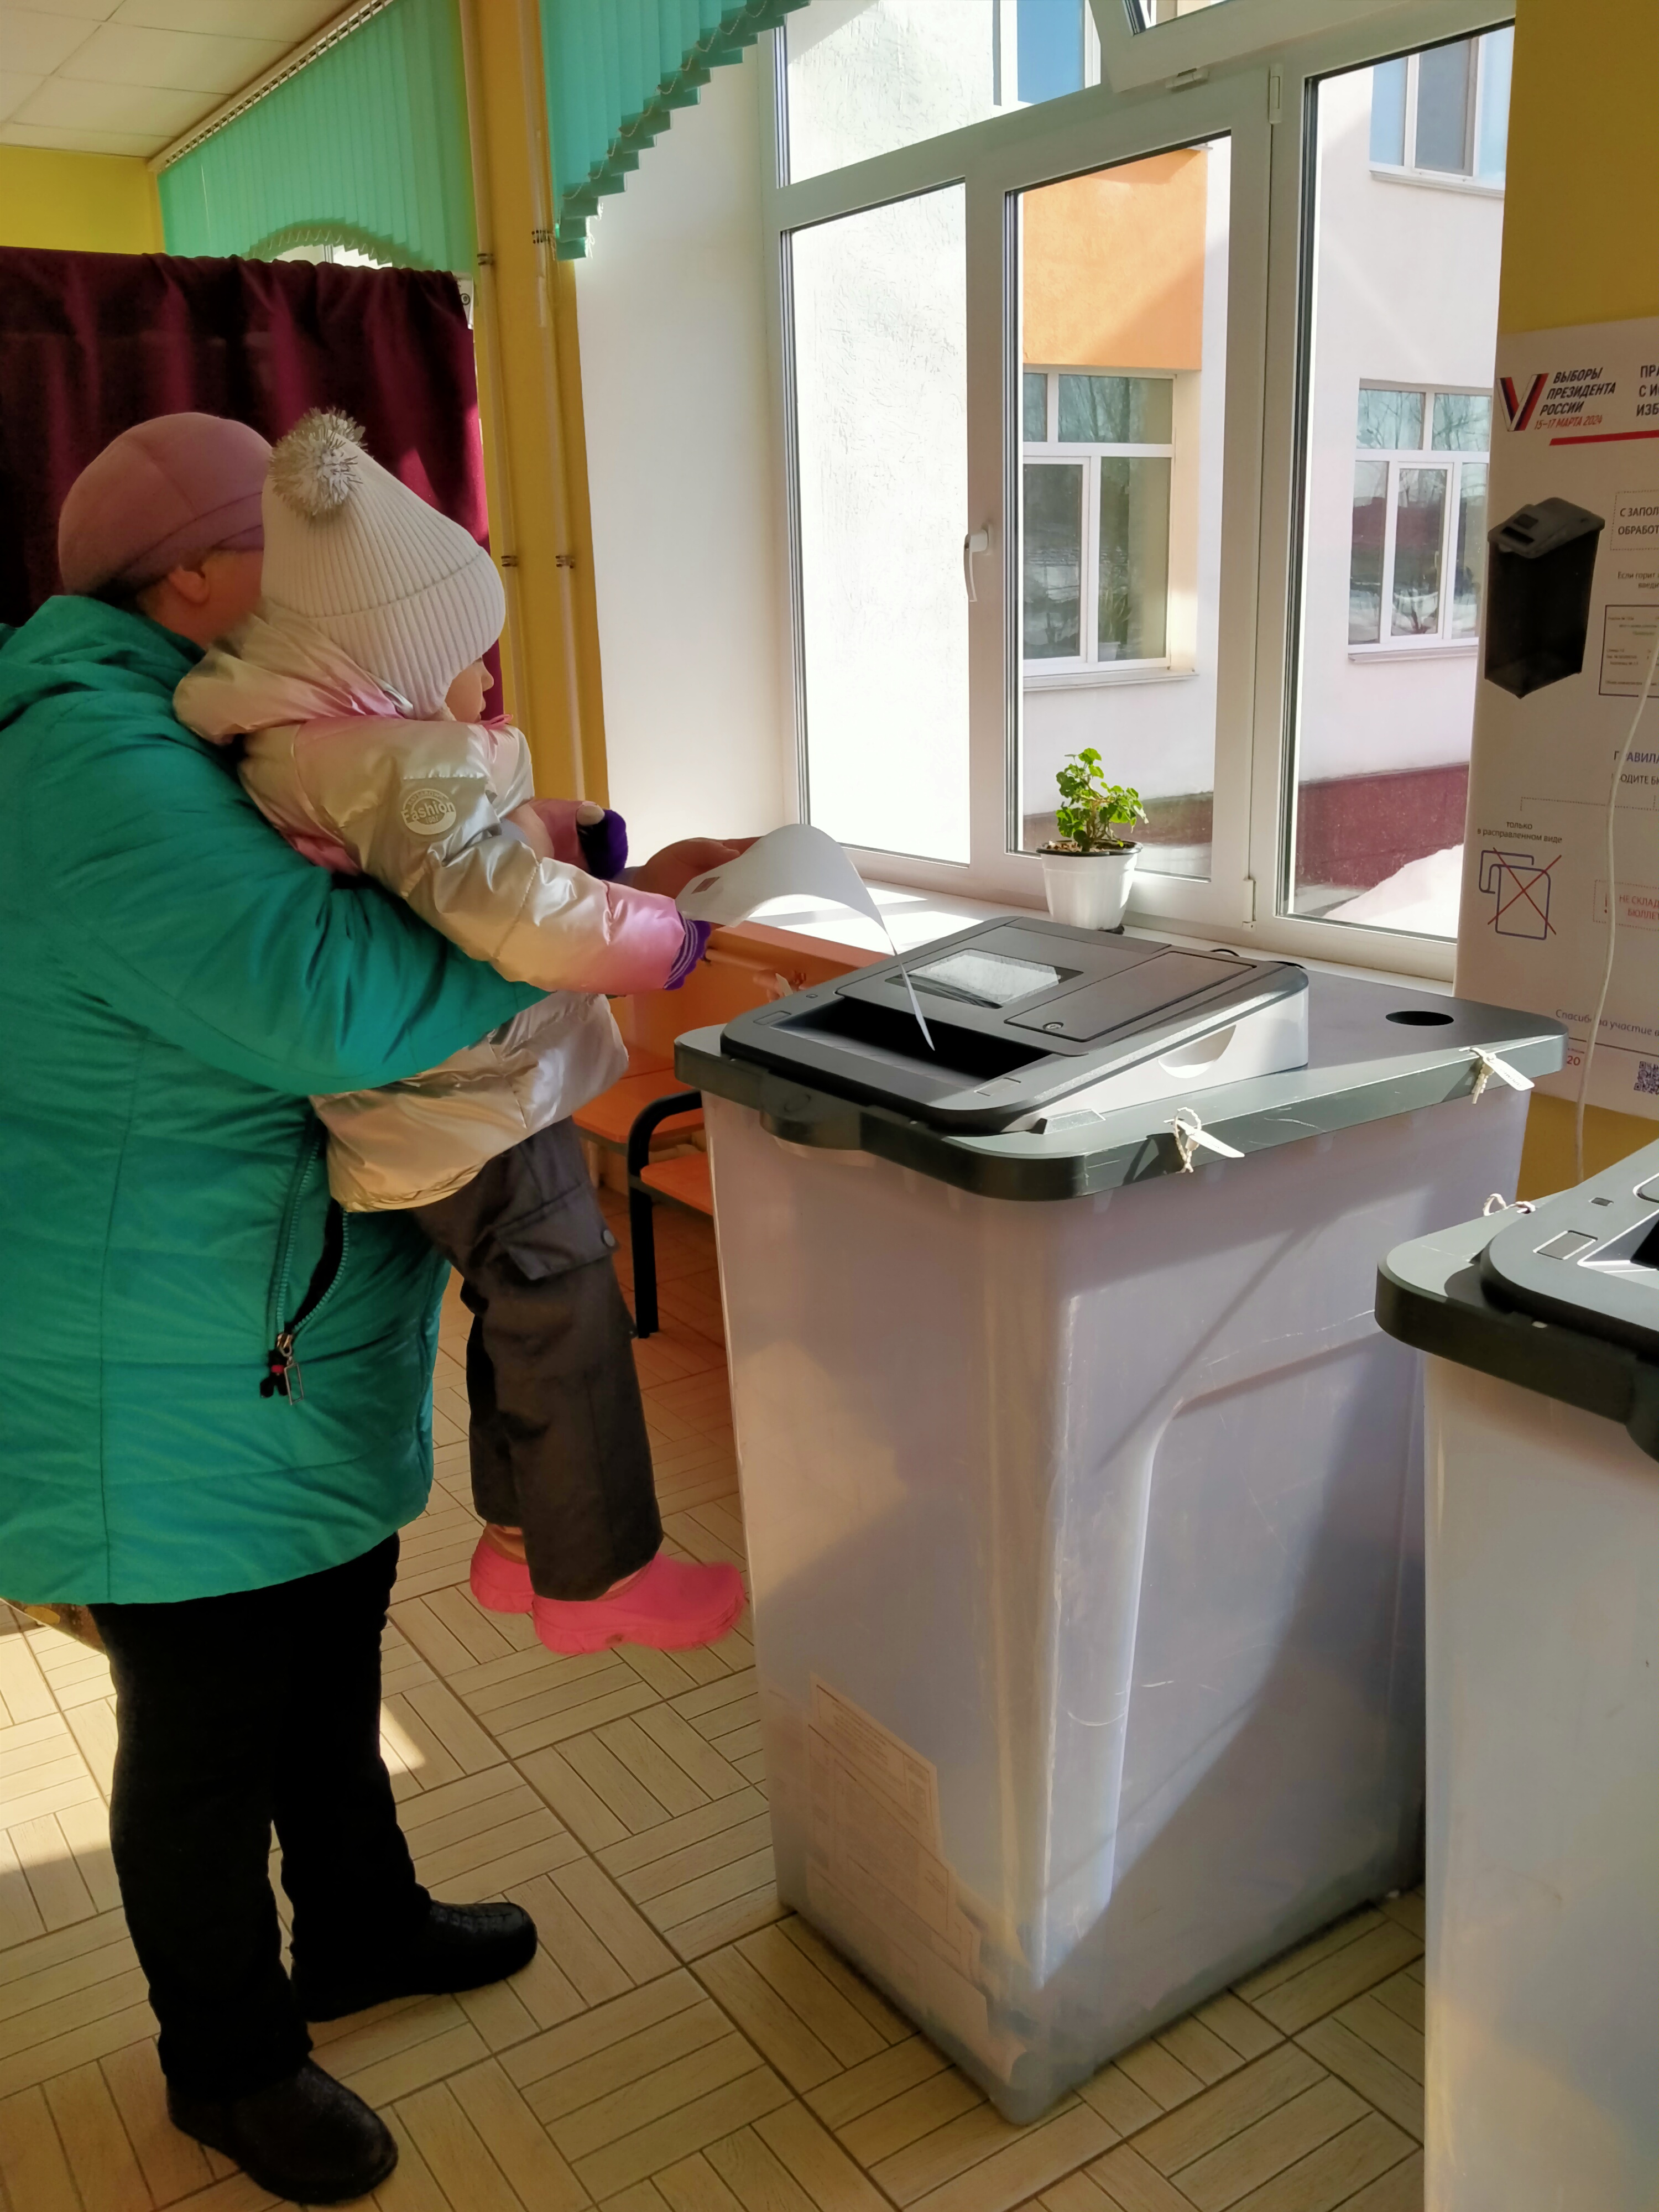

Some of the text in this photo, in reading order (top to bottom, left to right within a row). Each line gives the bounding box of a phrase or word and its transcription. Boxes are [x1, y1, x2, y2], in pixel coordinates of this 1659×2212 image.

[1553, 366, 1603, 384] ВЫБОРЫ
[1547, 382, 1616, 400] ПРЕЗИДЕНТА
[1639, 384, 1646, 398] С
[1540, 401, 1585, 416] РОССИИ
[1556, 416, 1582, 428] МАРТА
[1583, 415, 1603, 426] 2024
[1620, 508, 1626, 517] С
[401, 801, 456, 823] Fashion
[1506, 821, 1533, 830] только
[1483, 830, 1542, 841] расправленном
[1543, 836, 1562, 844] виде
[1619, 895, 1630, 903] НЕ
[1556, 1009, 1592, 1023] Спасиб
[1610, 1021, 1652, 1035] участие
